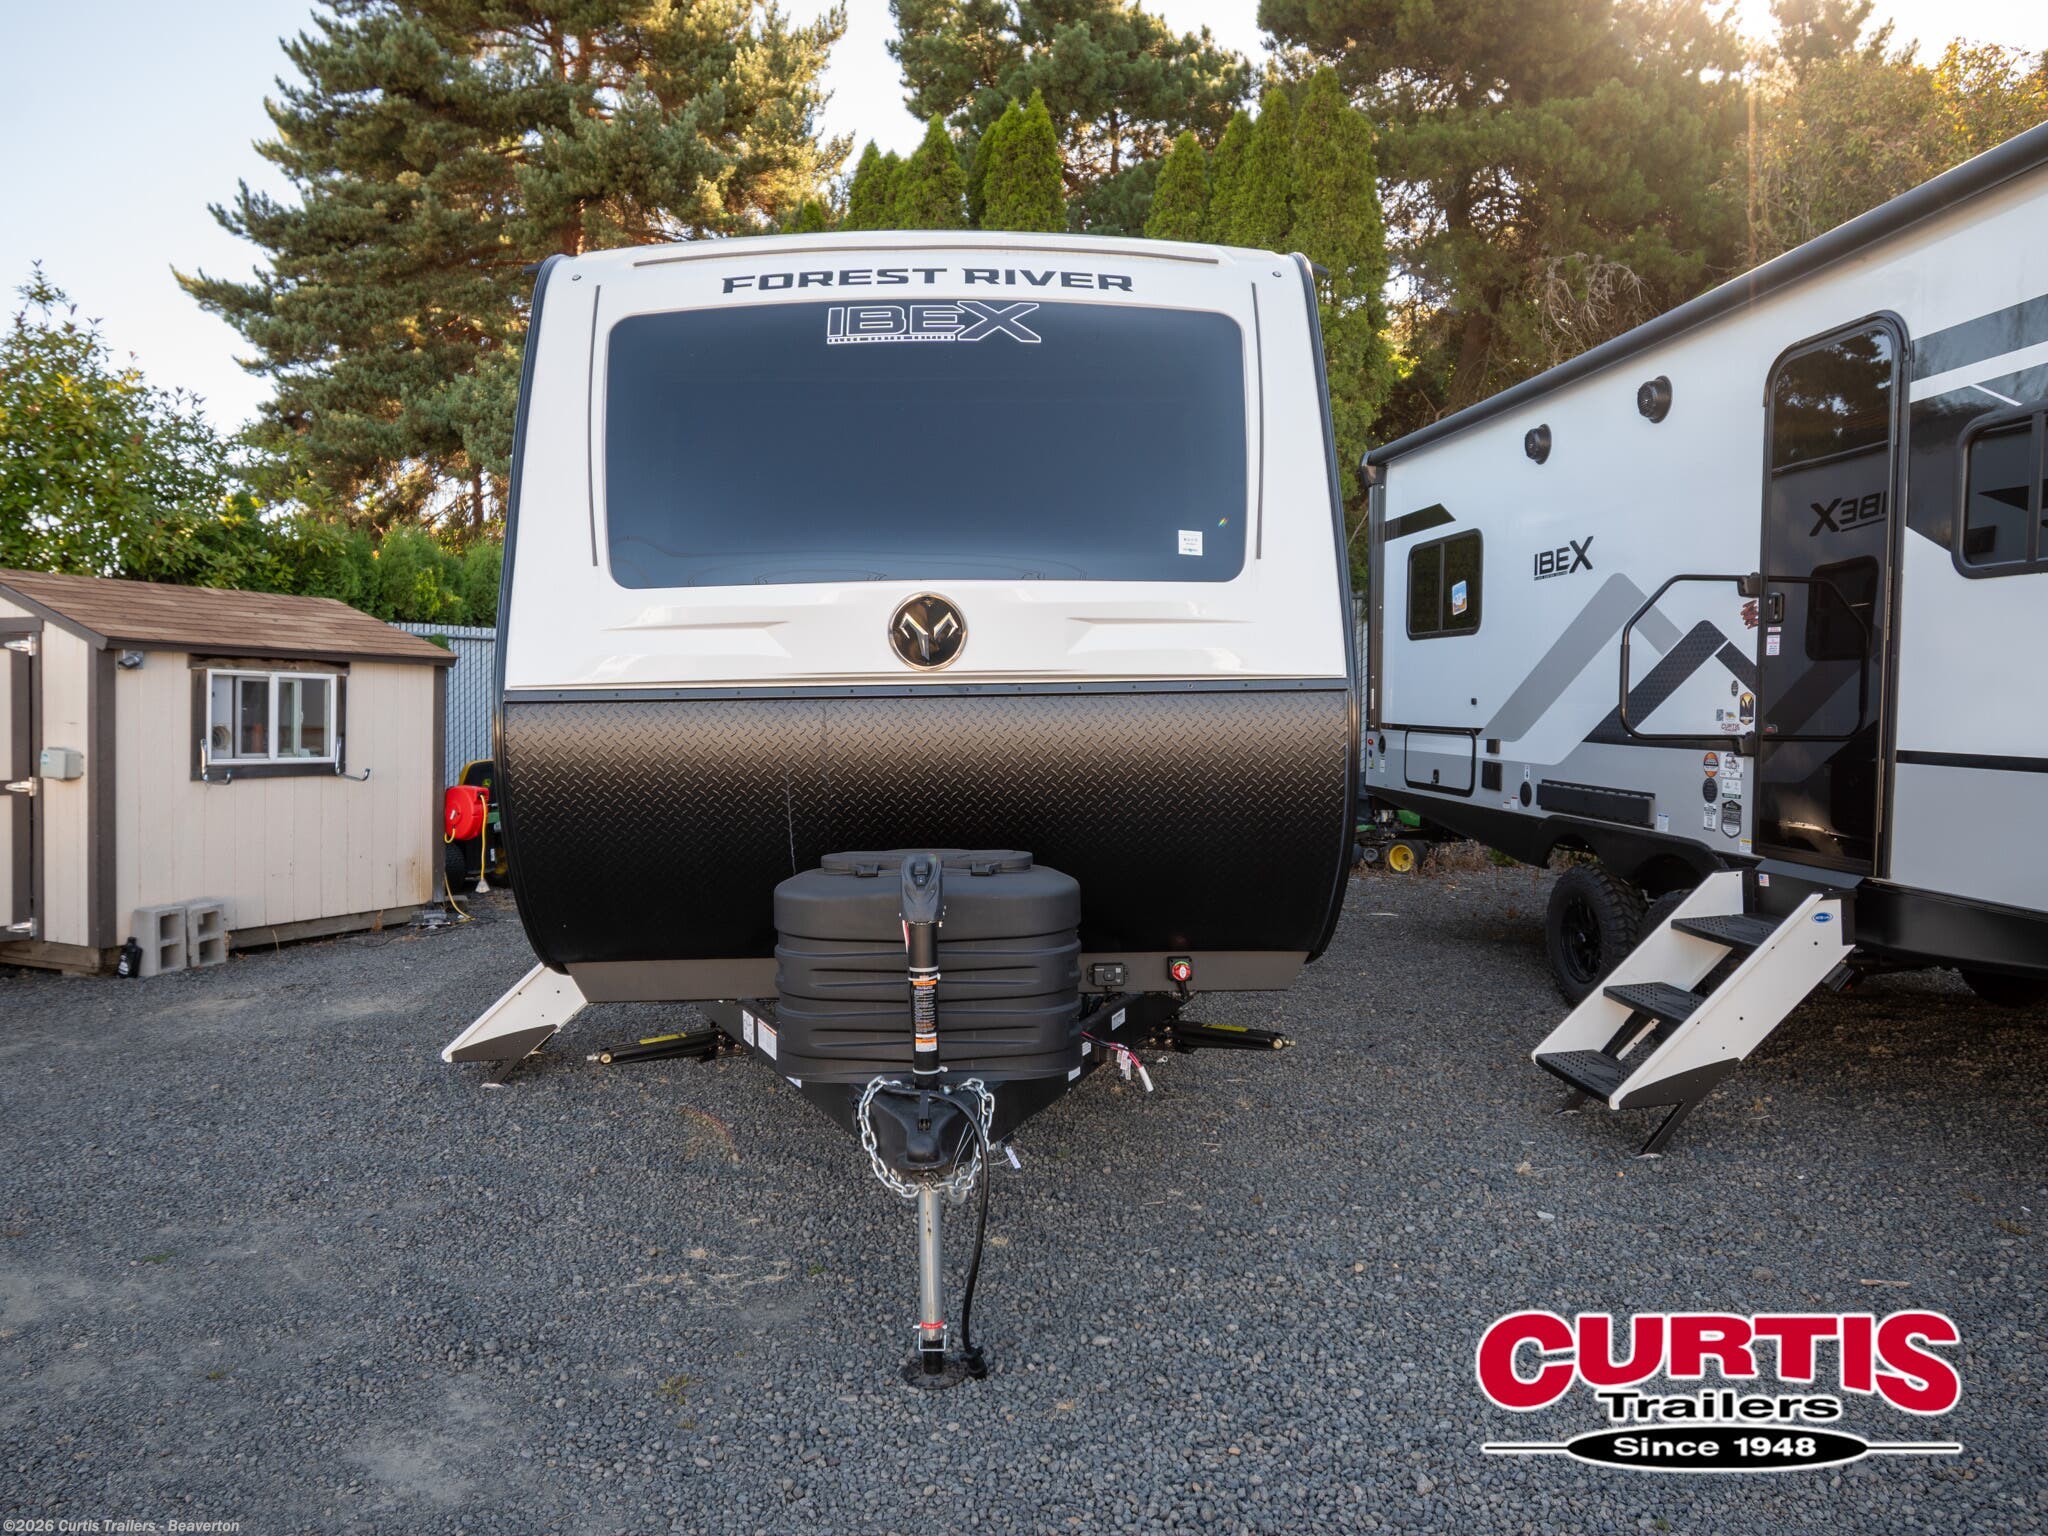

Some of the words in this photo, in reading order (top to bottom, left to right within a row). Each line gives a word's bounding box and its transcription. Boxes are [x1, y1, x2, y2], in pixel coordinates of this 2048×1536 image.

[722, 267, 948, 294] FOREST
[961, 267, 1134, 293] RIVER
[827, 301, 1042, 344] IBEX
[1534, 535, 1594, 577] IBEX
